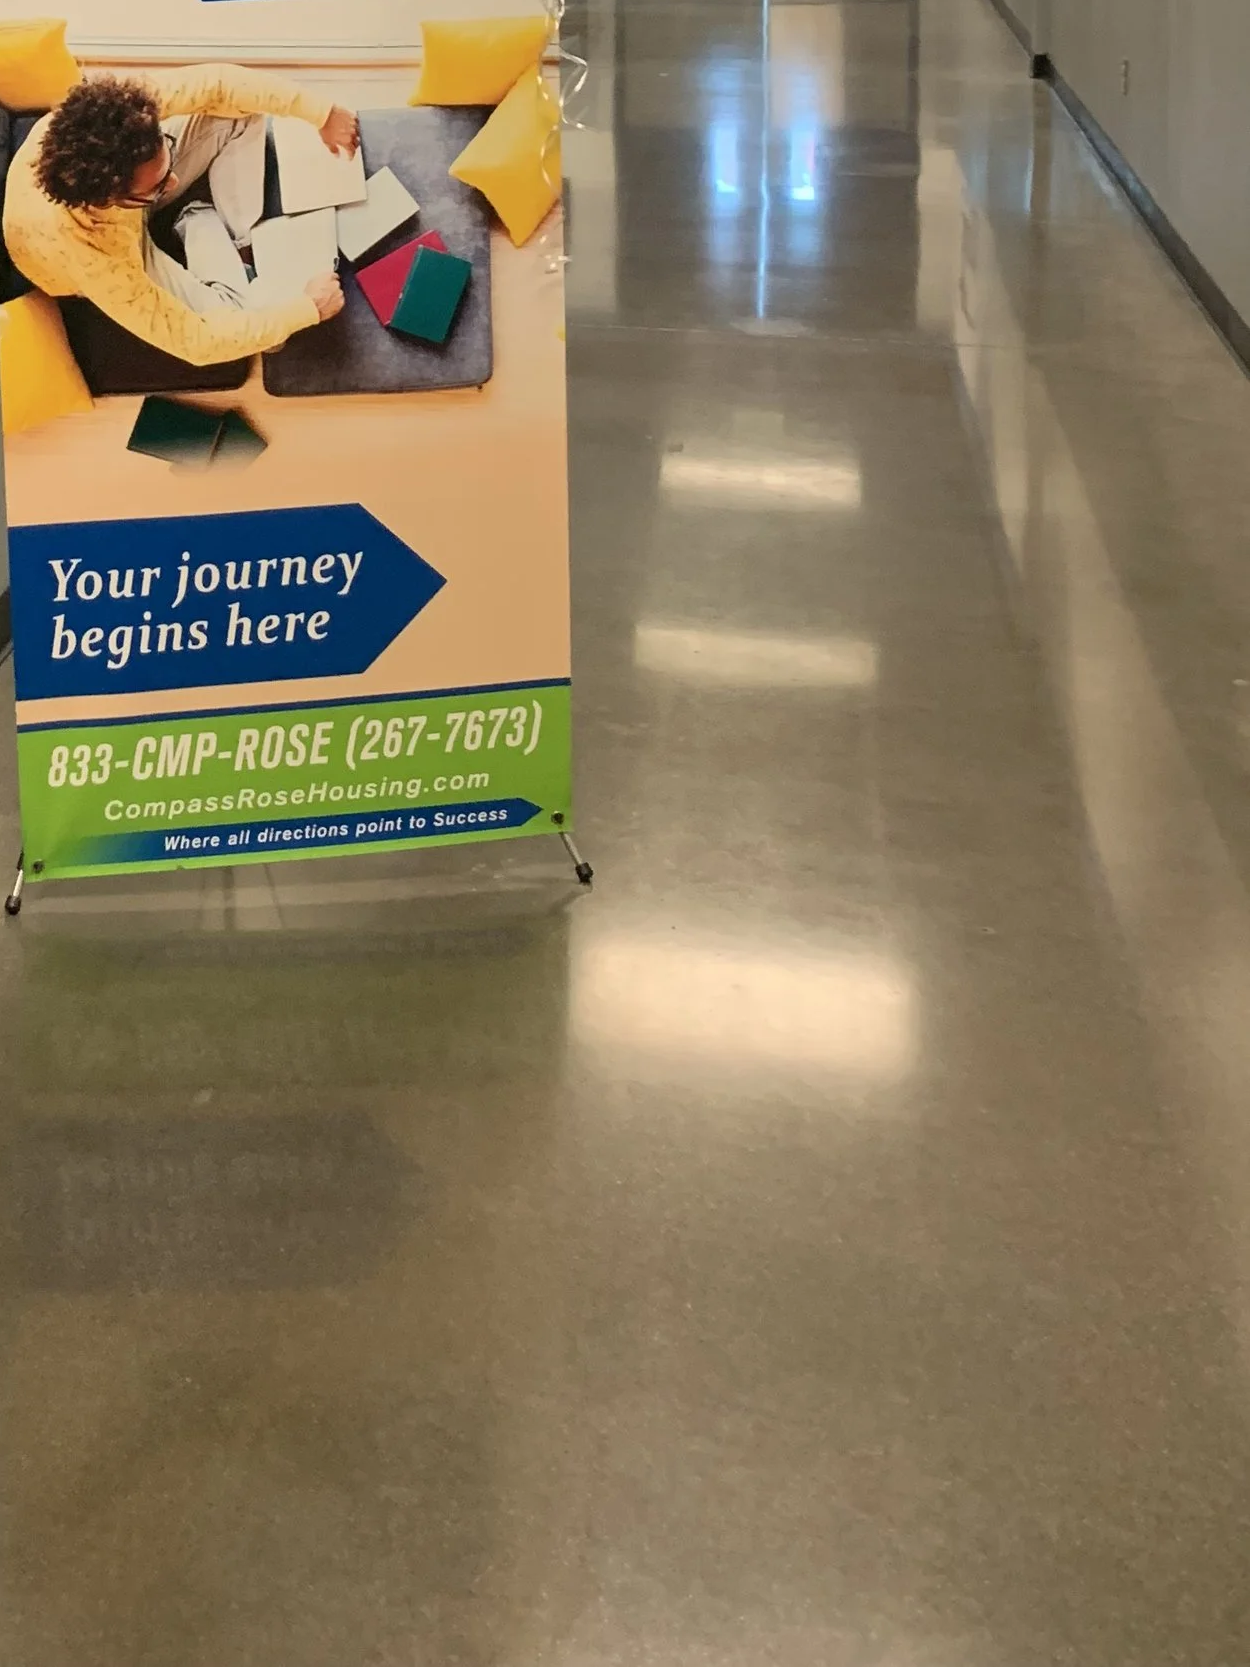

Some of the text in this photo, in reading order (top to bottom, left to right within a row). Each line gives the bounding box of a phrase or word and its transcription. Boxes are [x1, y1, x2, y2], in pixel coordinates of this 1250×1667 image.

[49, 551, 363, 609] Your journey
[51, 602, 330, 670] begins here
[47, 700, 542, 788] 833-CMP-ROSE (267-7673)
[104, 773, 489, 821] CompassRoseHousing.com
[164, 809, 508, 851] Where all directions point to Success
